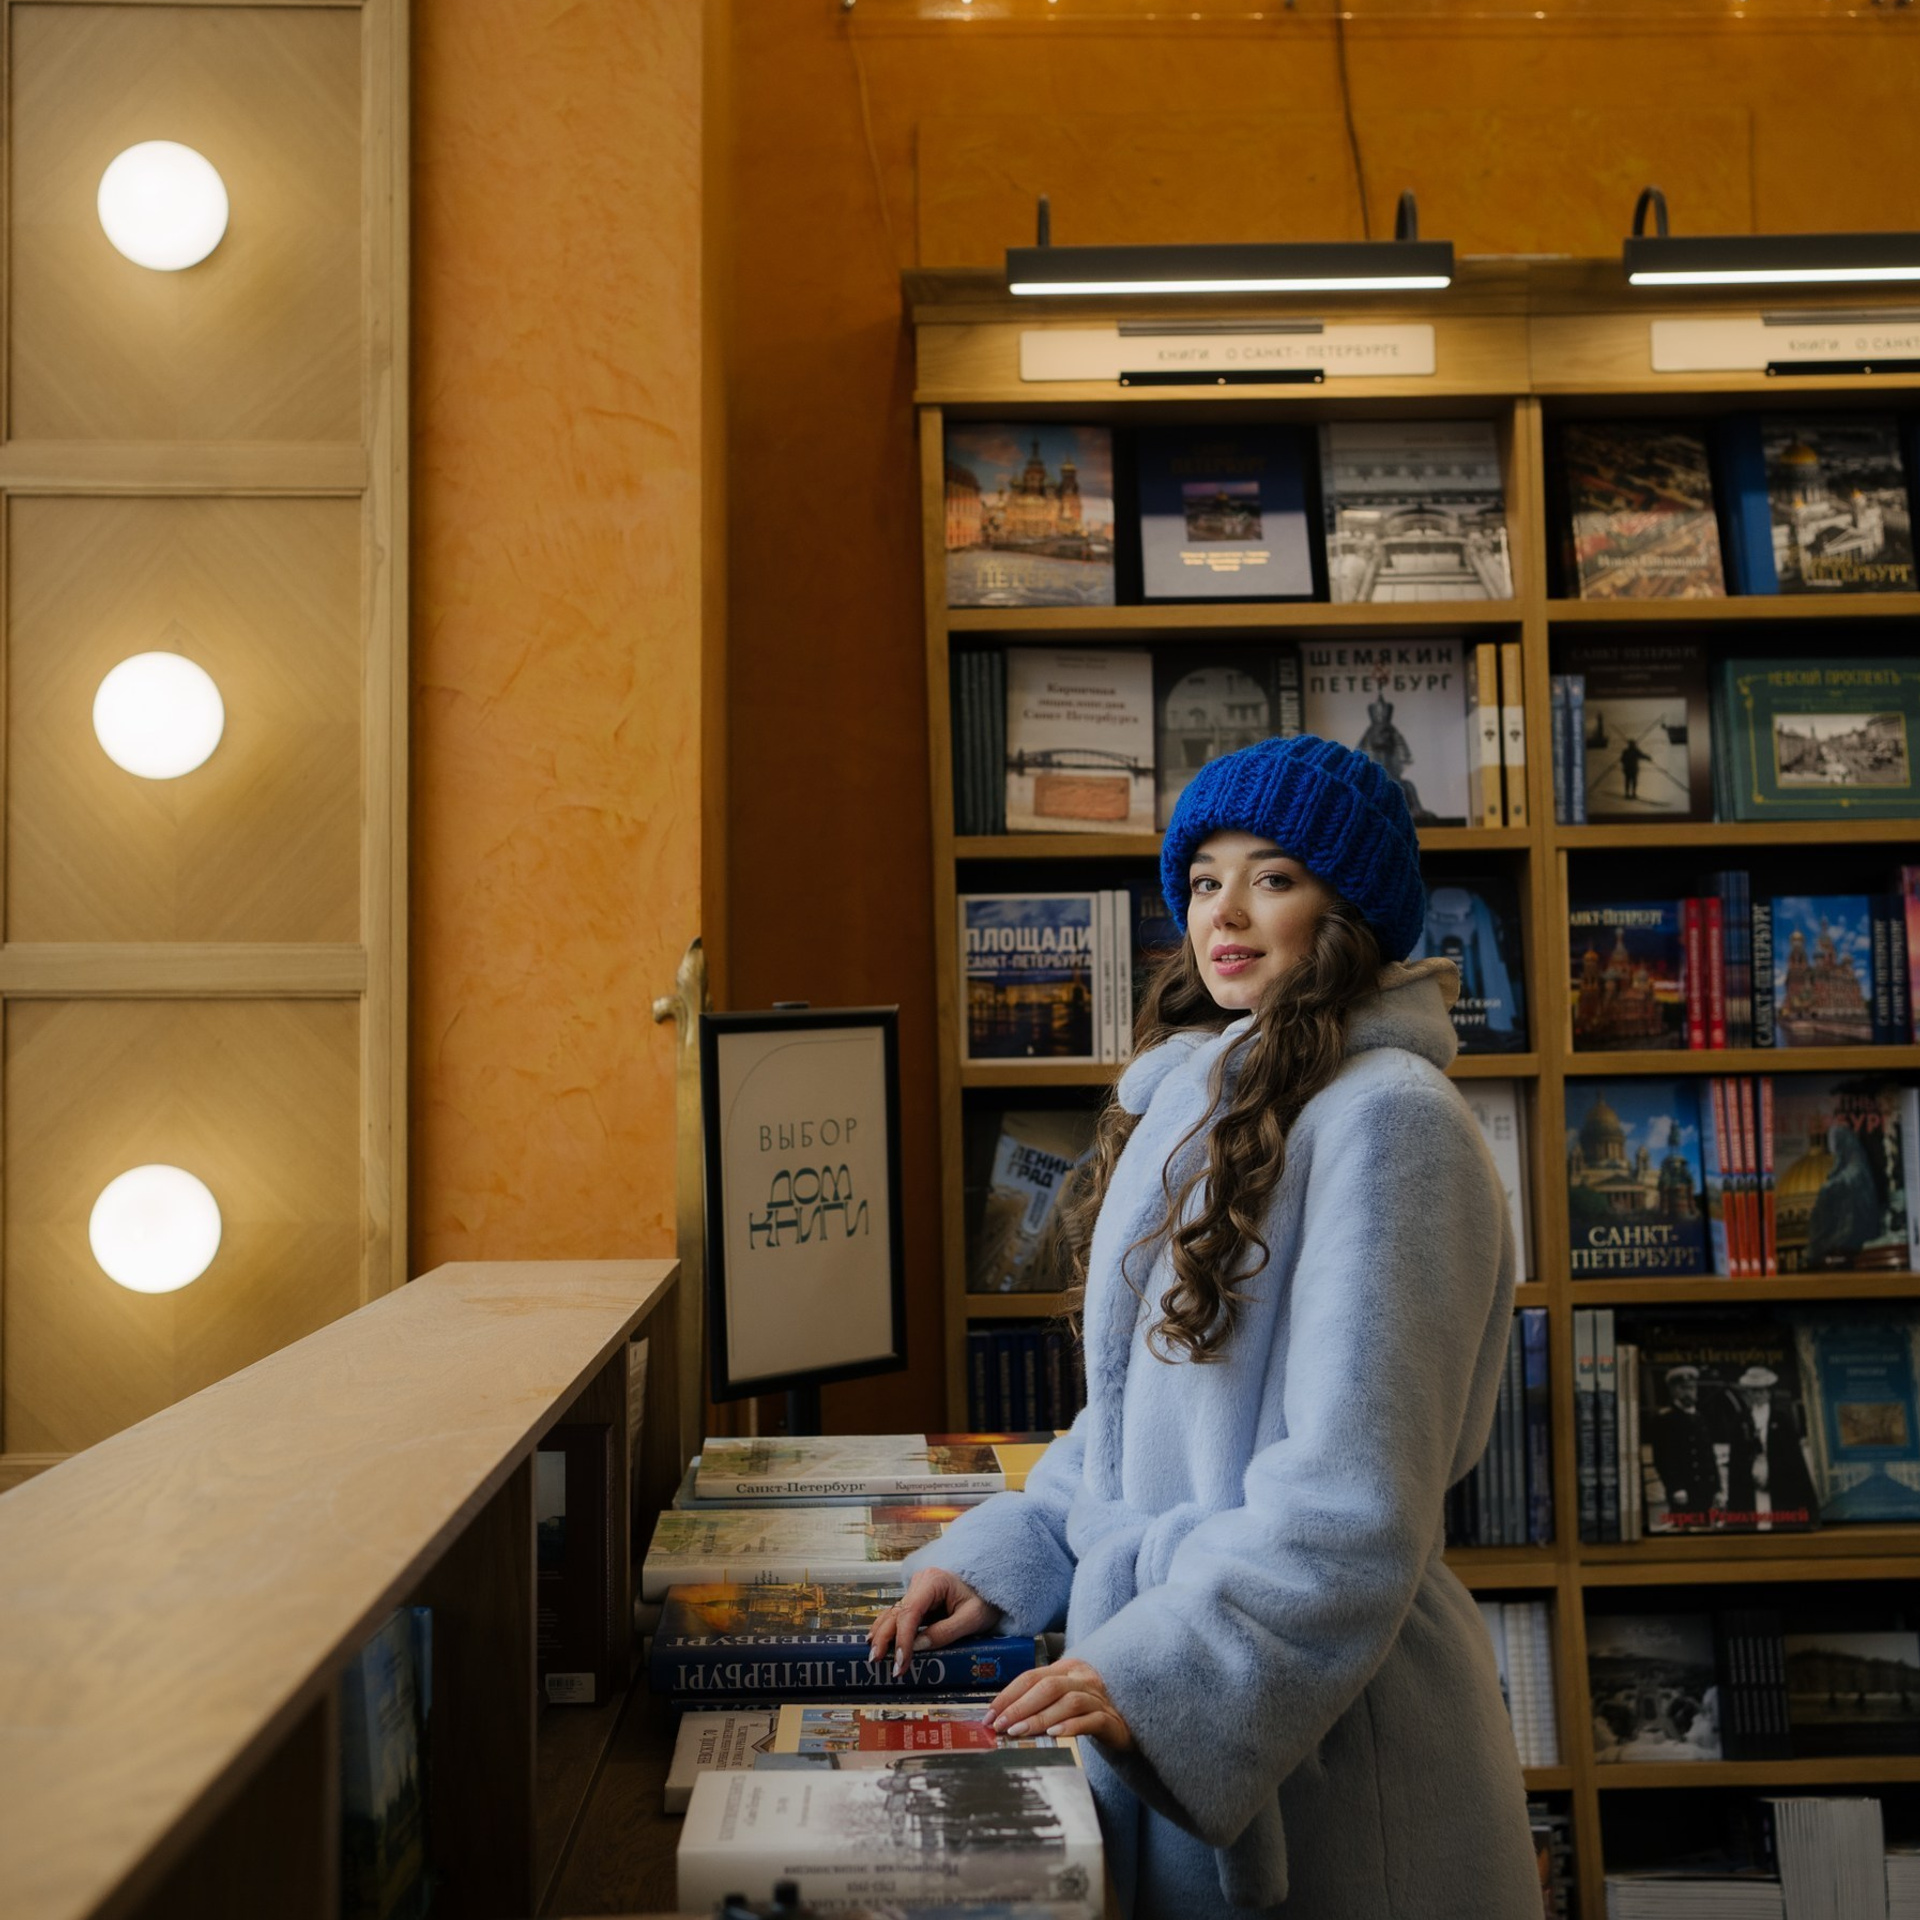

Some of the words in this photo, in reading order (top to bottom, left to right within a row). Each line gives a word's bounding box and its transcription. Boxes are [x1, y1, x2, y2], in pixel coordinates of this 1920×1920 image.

[1157, 347, 1210, 361] КНИГИ
[1225, 347, 1237, 361] О
[1305, 342, 1401, 359] ПЕТЕРБУРГЕ
[1310, 648, 1453, 666] ШЕМЯКИН
[1310, 674, 1452, 693] ПЕТЕРБУРГ
[966, 927, 1093, 953] ПЛОЩАДИ
[759, 1117, 857, 1151] ВЫБОР
[766, 1163, 853, 1210] ДОМ
[1007, 1162, 1054, 1188] ГРАД
[749, 1199, 870, 1250] КНИГИ
[1588, 1225, 1679, 1247] САНКТ-
[1571, 1246, 1699, 1270] ПЕТЕРБУРГ
[736, 1481, 866, 1495] Санкт-Петербург
[895, 1480, 969, 1491] Картографический
[972, 1480, 993, 1489] атлас
[672, 1657, 946, 1691] САНКТ-ПЕТЕРБУРГ
